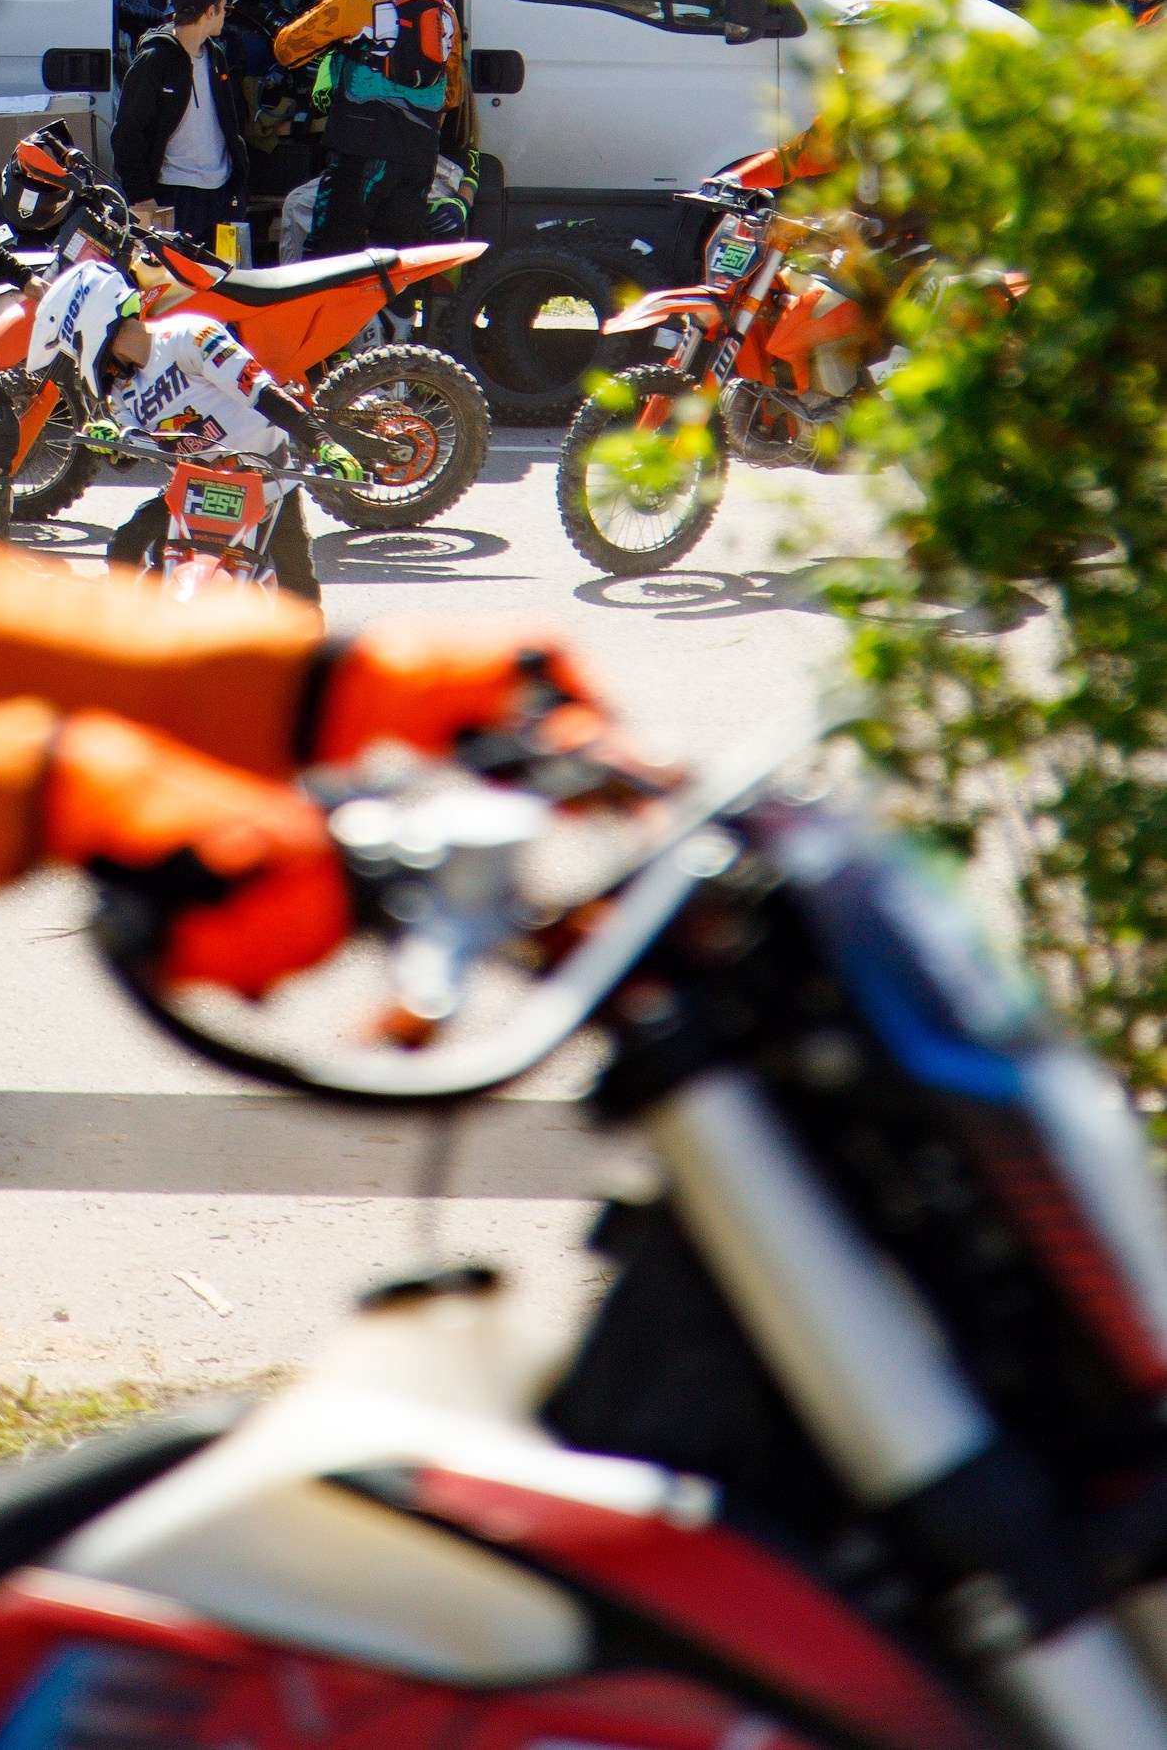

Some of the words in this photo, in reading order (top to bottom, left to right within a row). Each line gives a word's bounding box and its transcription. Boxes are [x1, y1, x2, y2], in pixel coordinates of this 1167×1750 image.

[722, 248, 748, 269] 257
[61, 285, 90, 344] 100%
[203, 491, 243, 517] 254
